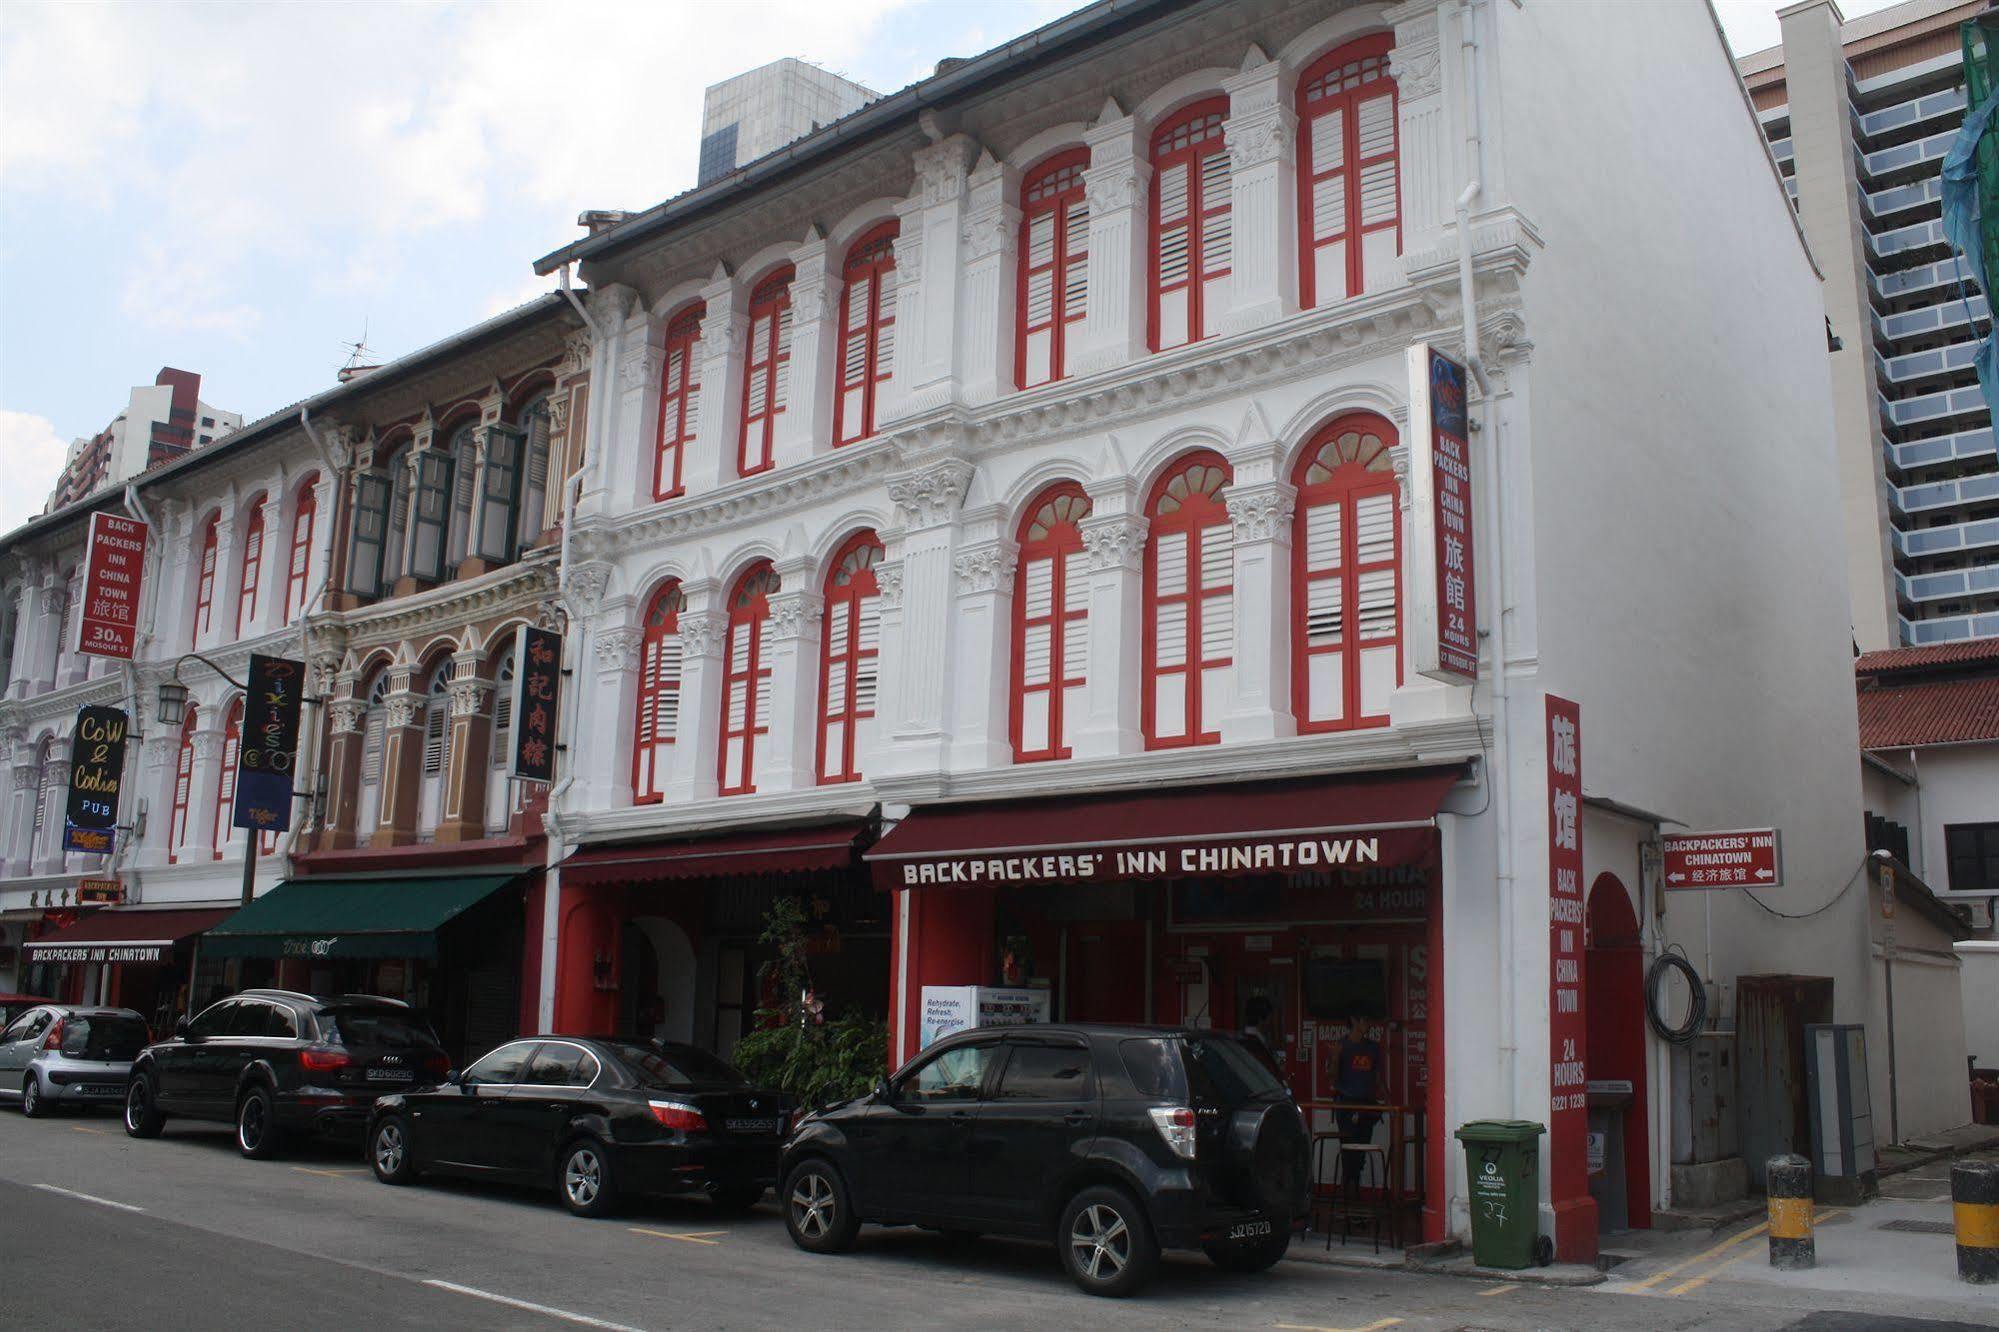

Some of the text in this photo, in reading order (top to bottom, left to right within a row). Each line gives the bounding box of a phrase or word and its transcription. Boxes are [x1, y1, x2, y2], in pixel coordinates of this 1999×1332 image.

[1439, 435, 1461, 460] BACK
[1433, 450, 1469, 482] PACKERS
[1444, 474, 1459, 494] INN
[1440, 492, 1464, 516] CHINA
[107, 519, 135, 534] BACK
[1441, 509, 1464, 534] TOWN
[96, 534, 142, 552] PACKERS
[108, 553, 126, 565] INN
[99, 569, 130, 584] CHINA
[99, 587, 128, 600] TOWN
[92, 599, 130, 621] 旅馆
[1449, 613, 1465, 632] 24
[93, 626, 122, 644] 30A
[1444, 629, 1470, 648] HOURS
[84, 640, 129, 653] MOSQUE ST
[1448, 653, 1469, 670] MOSQUE
[1468, 661, 1475, 672] ST
[89, 744, 109, 763] &
[82, 800, 110, 816] PUB
[1664, 836, 1772, 852] BACKPACKERS' INN
[1116, 850, 1166, 874] INN
[1180, 837, 1379, 872] CHINATOWN
[1685, 852, 1752, 866] CHINATOWN
[1557, 868, 1576, 894] BACK
[1692, 867, 1746, 882] 经济旅馆
[1560, 929, 1574, 953] INN
[90, 948, 105, 961] INN
[108, 947, 160, 961] CHINATOWN
[1556, 959, 1578, 983] CHINA
[927, 999, 961, 1008] Rehydrate,
[1556, 989, 1578, 1013] TOWN
[927, 1008, 952, 1016] Refresh,
[927, 1017, 964, 1026] Re-energise
[1563, 1039, 1575, 1061] 24
[1553, 1062, 1584, 1086] HOURS
[1551, 1096, 1568, 1111] 6221
